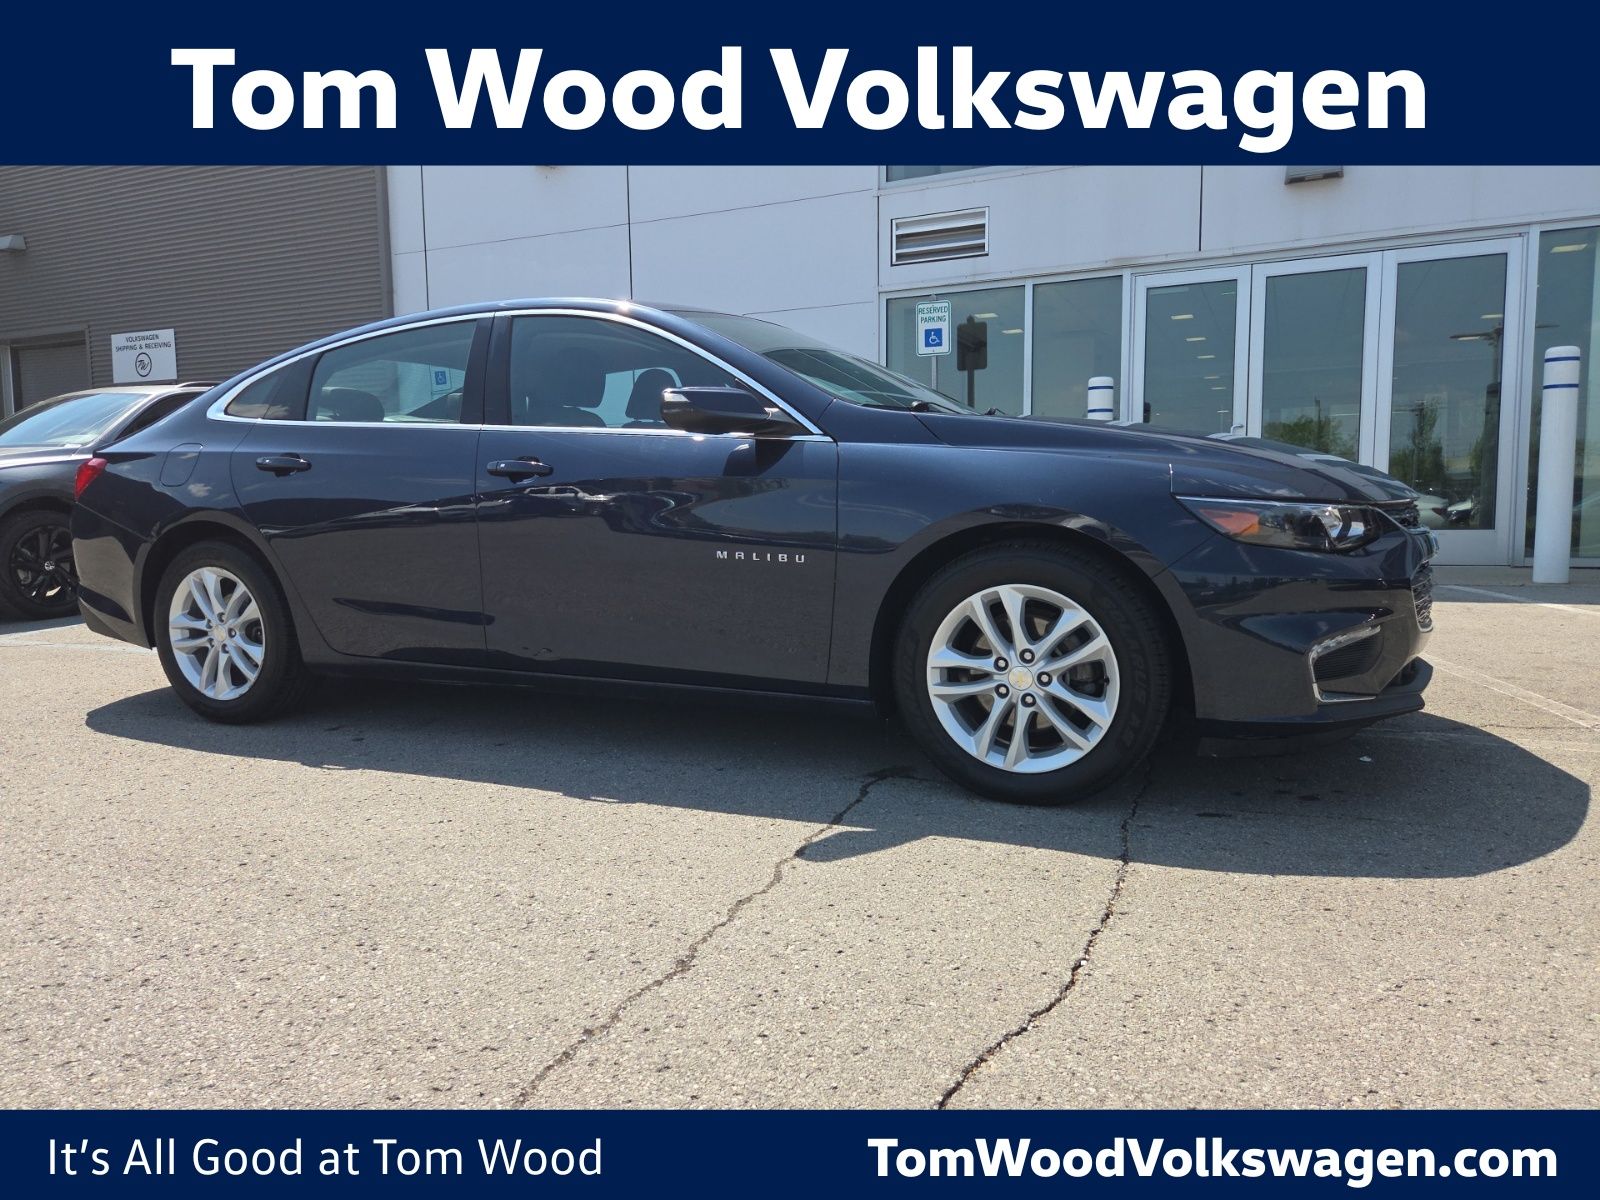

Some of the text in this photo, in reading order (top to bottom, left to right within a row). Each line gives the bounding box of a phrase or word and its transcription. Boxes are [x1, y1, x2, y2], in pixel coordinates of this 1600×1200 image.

[918, 305, 949, 315] RESERVED
[920, 314, 947, 324] PARKING
[125, 334, 160, 343] VOLKSWAGEN
[115, 344, 138, 352] SHIPPING
[144, 341, 172, 350] RECEIVING
[716, 550, 805, 563] MALIBU
